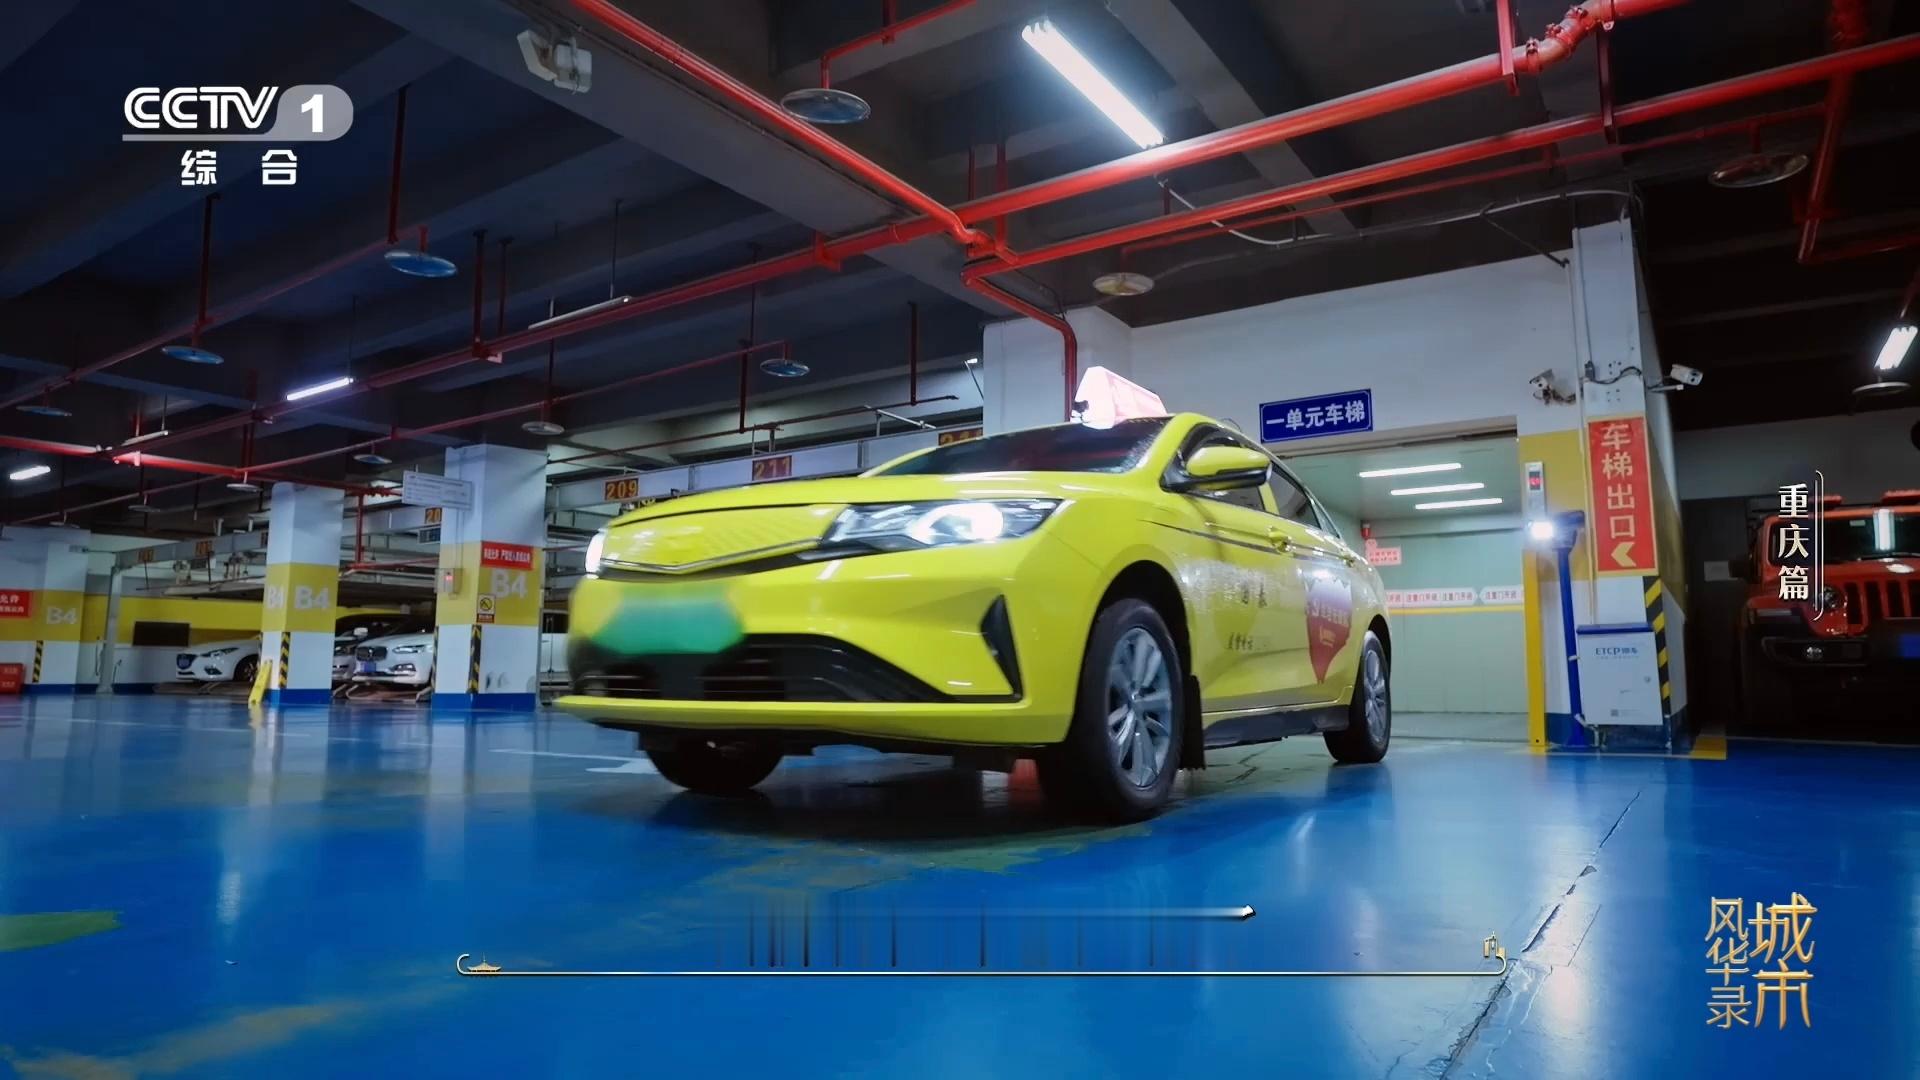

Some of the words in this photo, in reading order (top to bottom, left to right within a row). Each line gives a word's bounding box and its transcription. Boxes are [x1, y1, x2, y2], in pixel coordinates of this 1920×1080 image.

[1266, 401, 1366, 432] 一单元车梯
[755, 457, 791, 479] 211
[605, 480, 638, 499] 209
[1600, 423, 1636, 539] 车梯出口
[294, 585, 330, 610] B4
[491, 571, 527, 600] B4
[46, 606, 77, 625] B4
